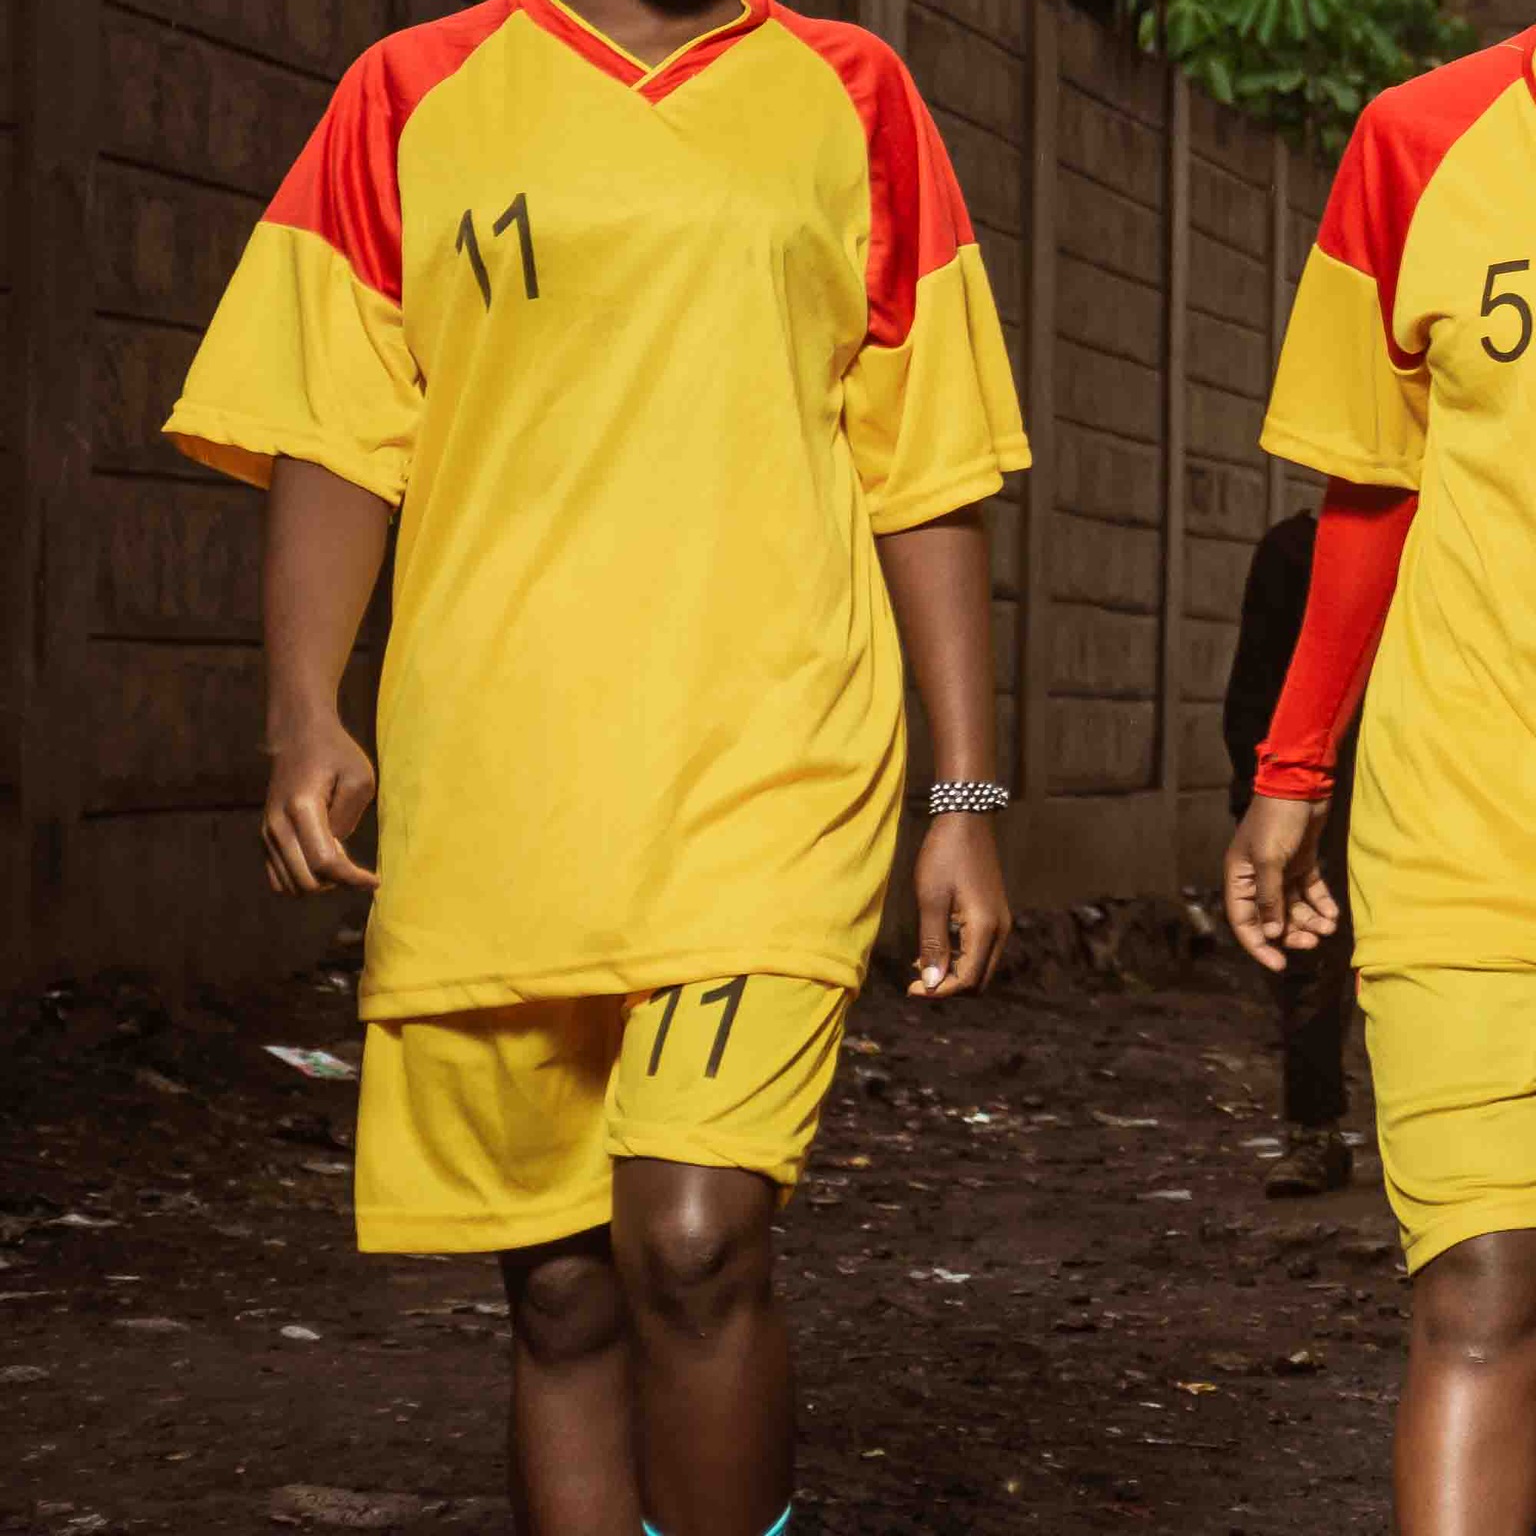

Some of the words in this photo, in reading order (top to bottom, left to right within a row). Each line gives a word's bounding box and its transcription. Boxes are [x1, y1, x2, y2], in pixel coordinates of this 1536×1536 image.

[463, 199, 538, 308] 11
[1481, 260, 1532, 363] 5
[647, 973, 748, 1078] 11
